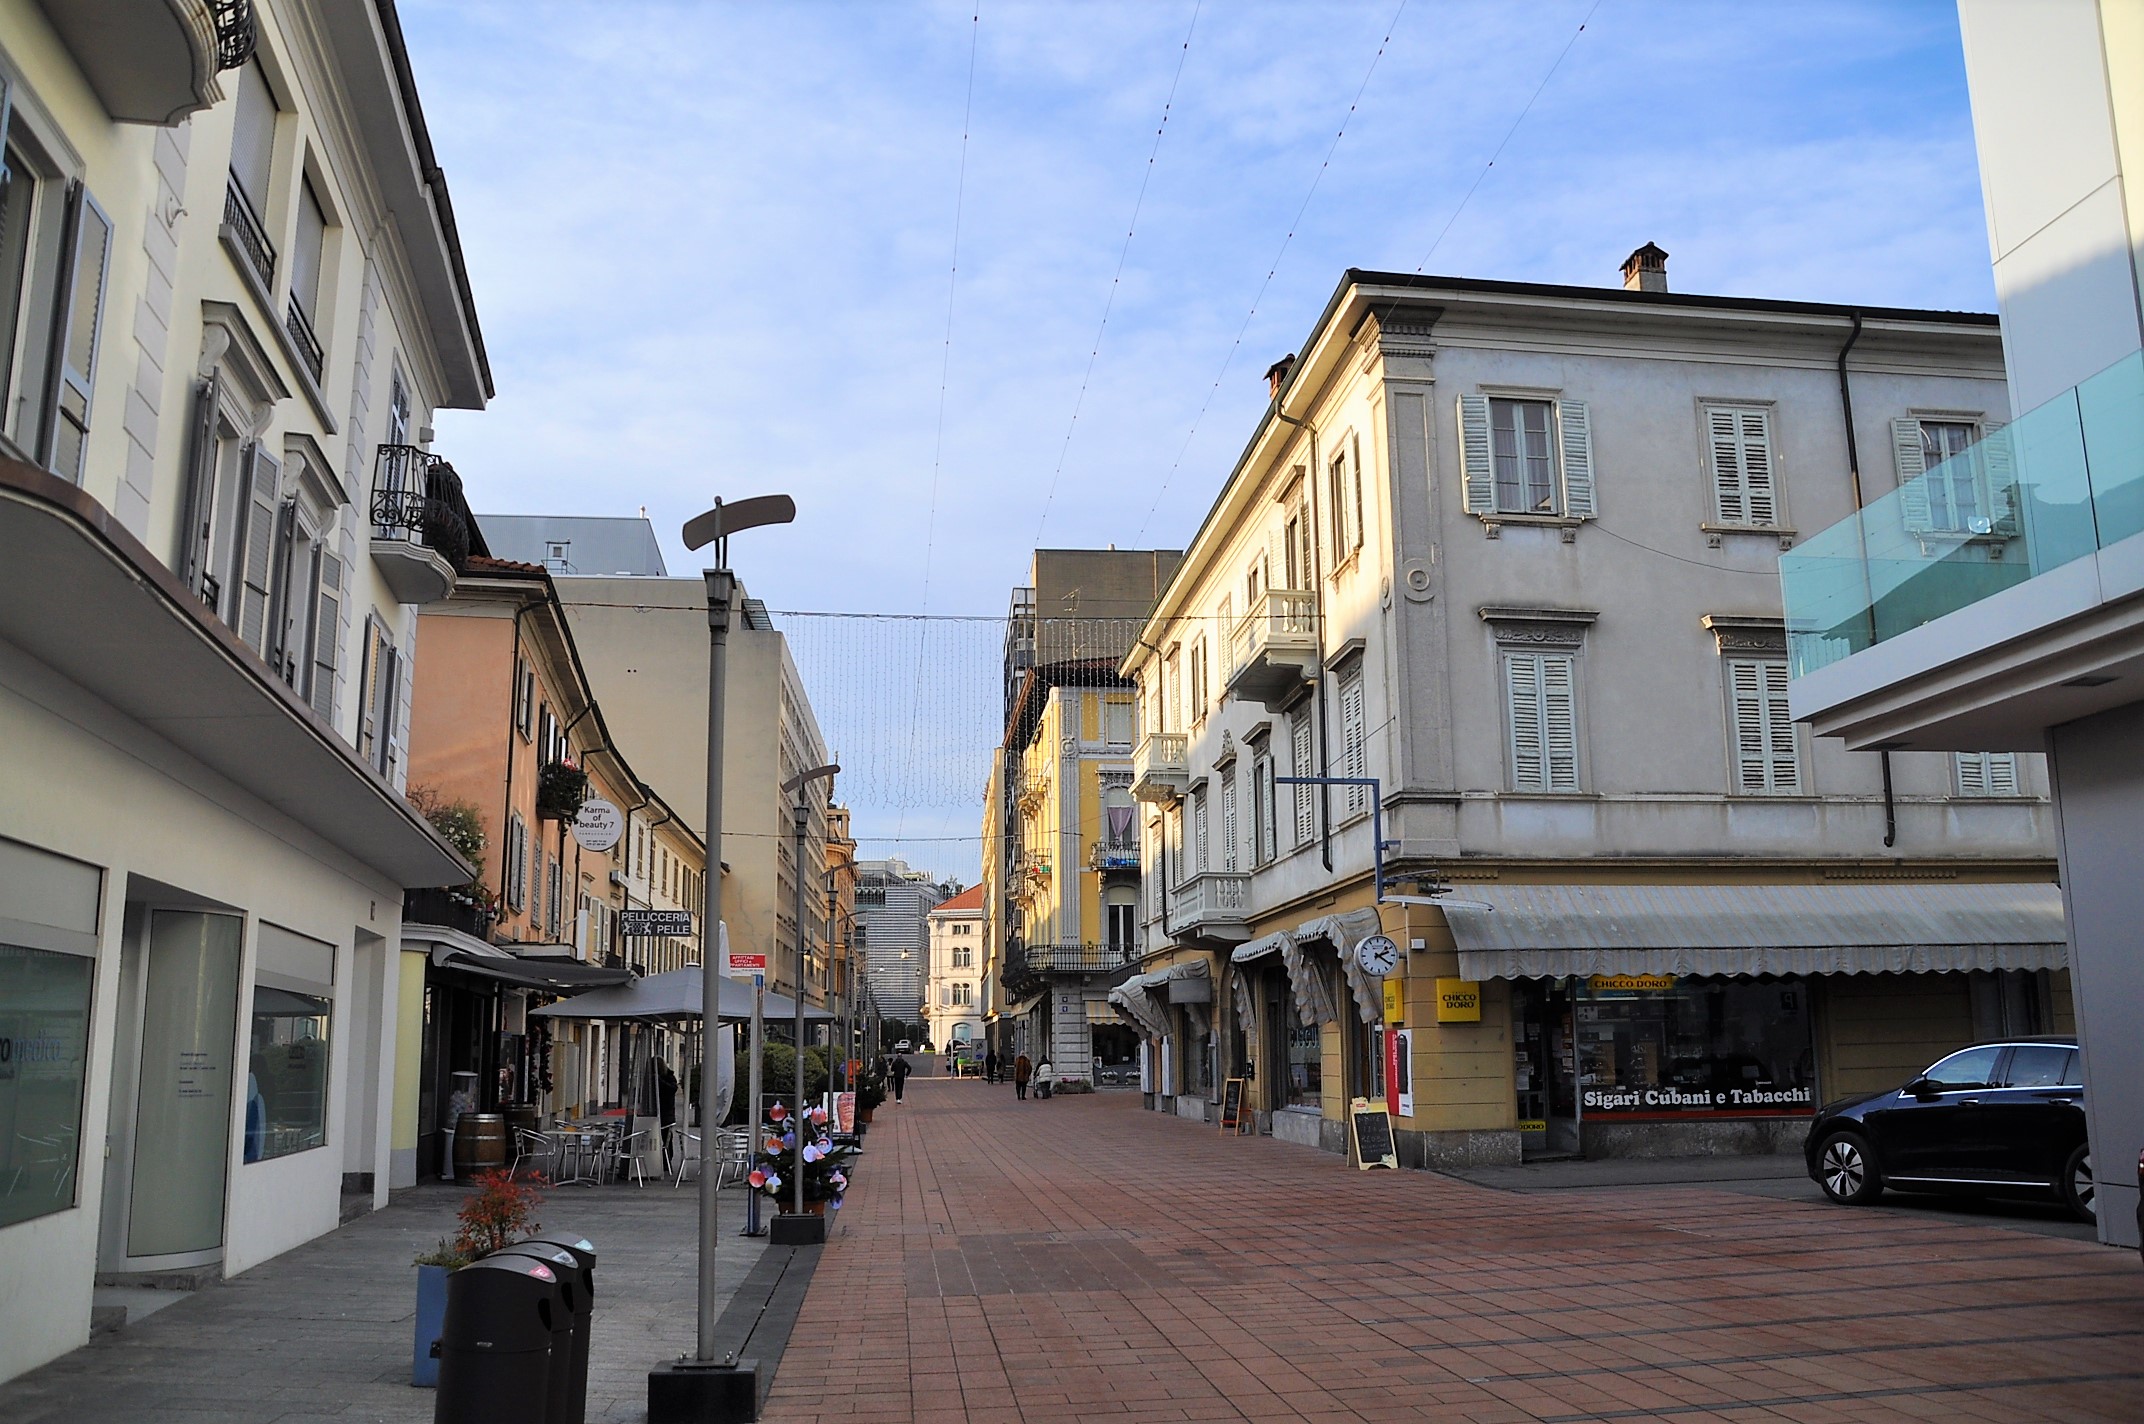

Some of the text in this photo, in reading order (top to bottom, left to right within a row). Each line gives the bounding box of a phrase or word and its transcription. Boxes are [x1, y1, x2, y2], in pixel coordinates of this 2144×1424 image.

[584, 806, 611, 814] Karma
[579, 821, 608, 830] beauty
[621, 912, 691, 922] PELLICCERIA
[656, 924, 691, 935] PELLE
[1594, 980, 1634, 988] CHICCO
[1442, 994, 1477, 1002] CHICCO
[1584, 1086, 1811, 1109] Sigari Cubani e Tabacchi
